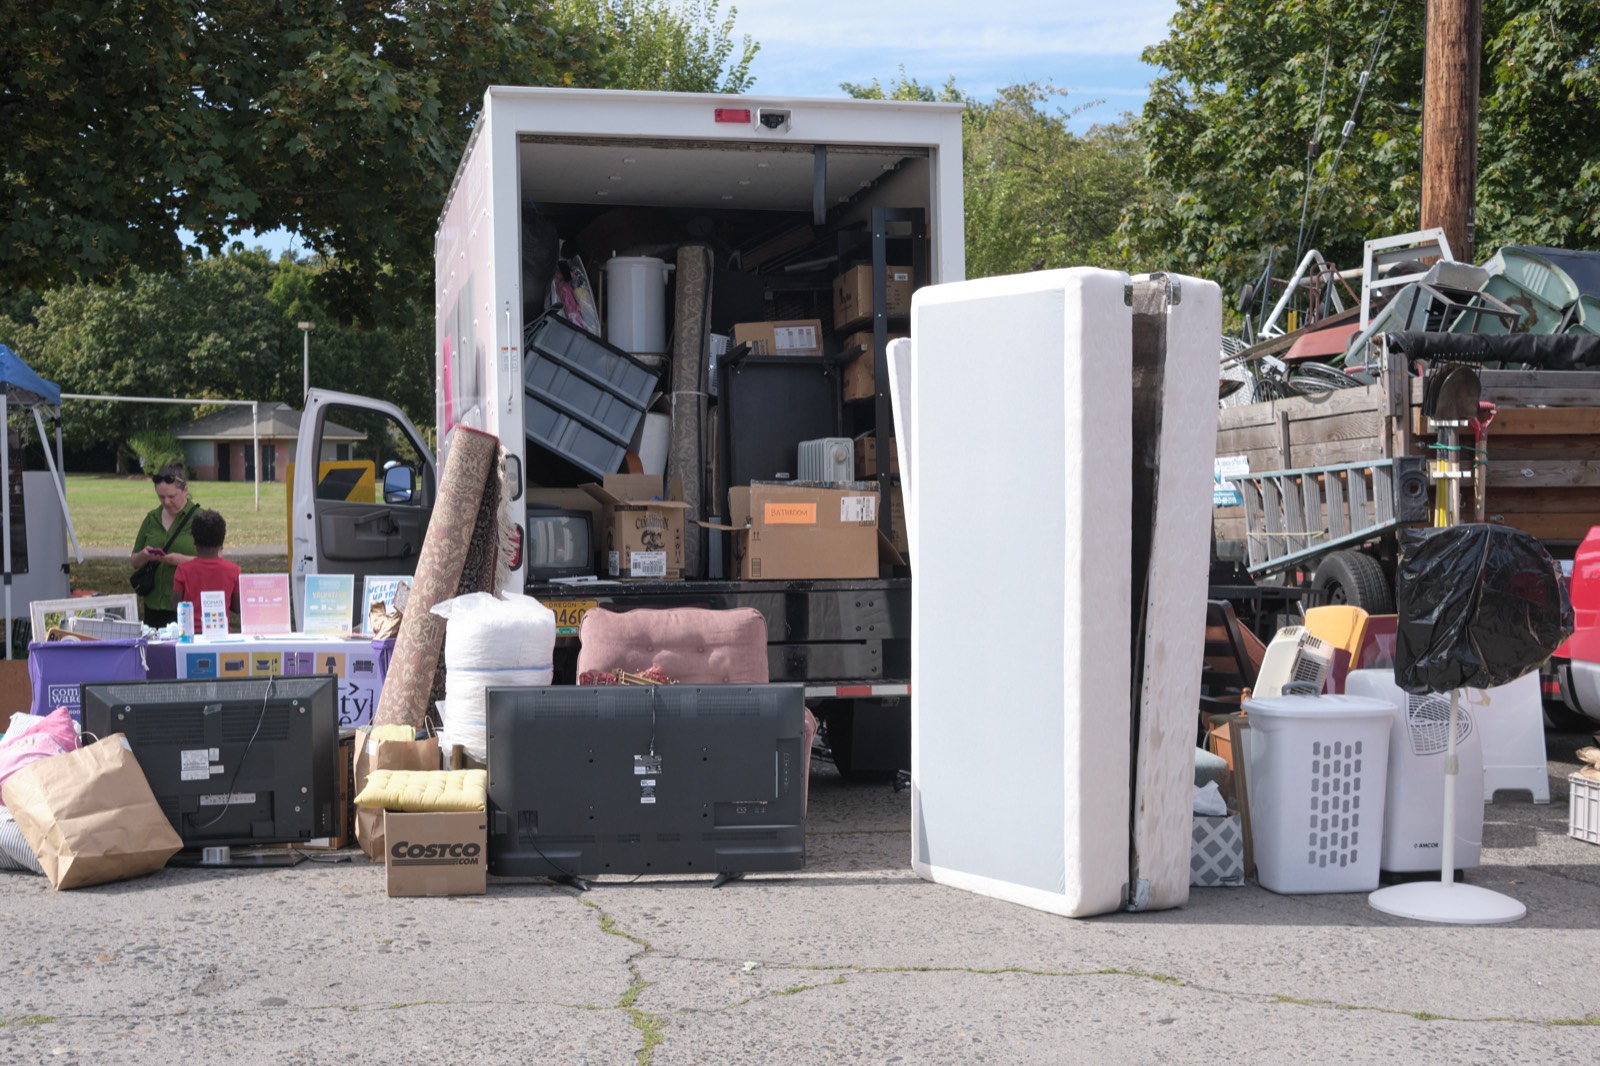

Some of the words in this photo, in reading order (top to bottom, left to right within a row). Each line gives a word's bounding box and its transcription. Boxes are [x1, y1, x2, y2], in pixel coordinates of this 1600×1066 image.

[770, 508, 808, 517] BATHROOM
[372, 592, 383, 601] UP
[391, 841, 480, 858] COSTCO
